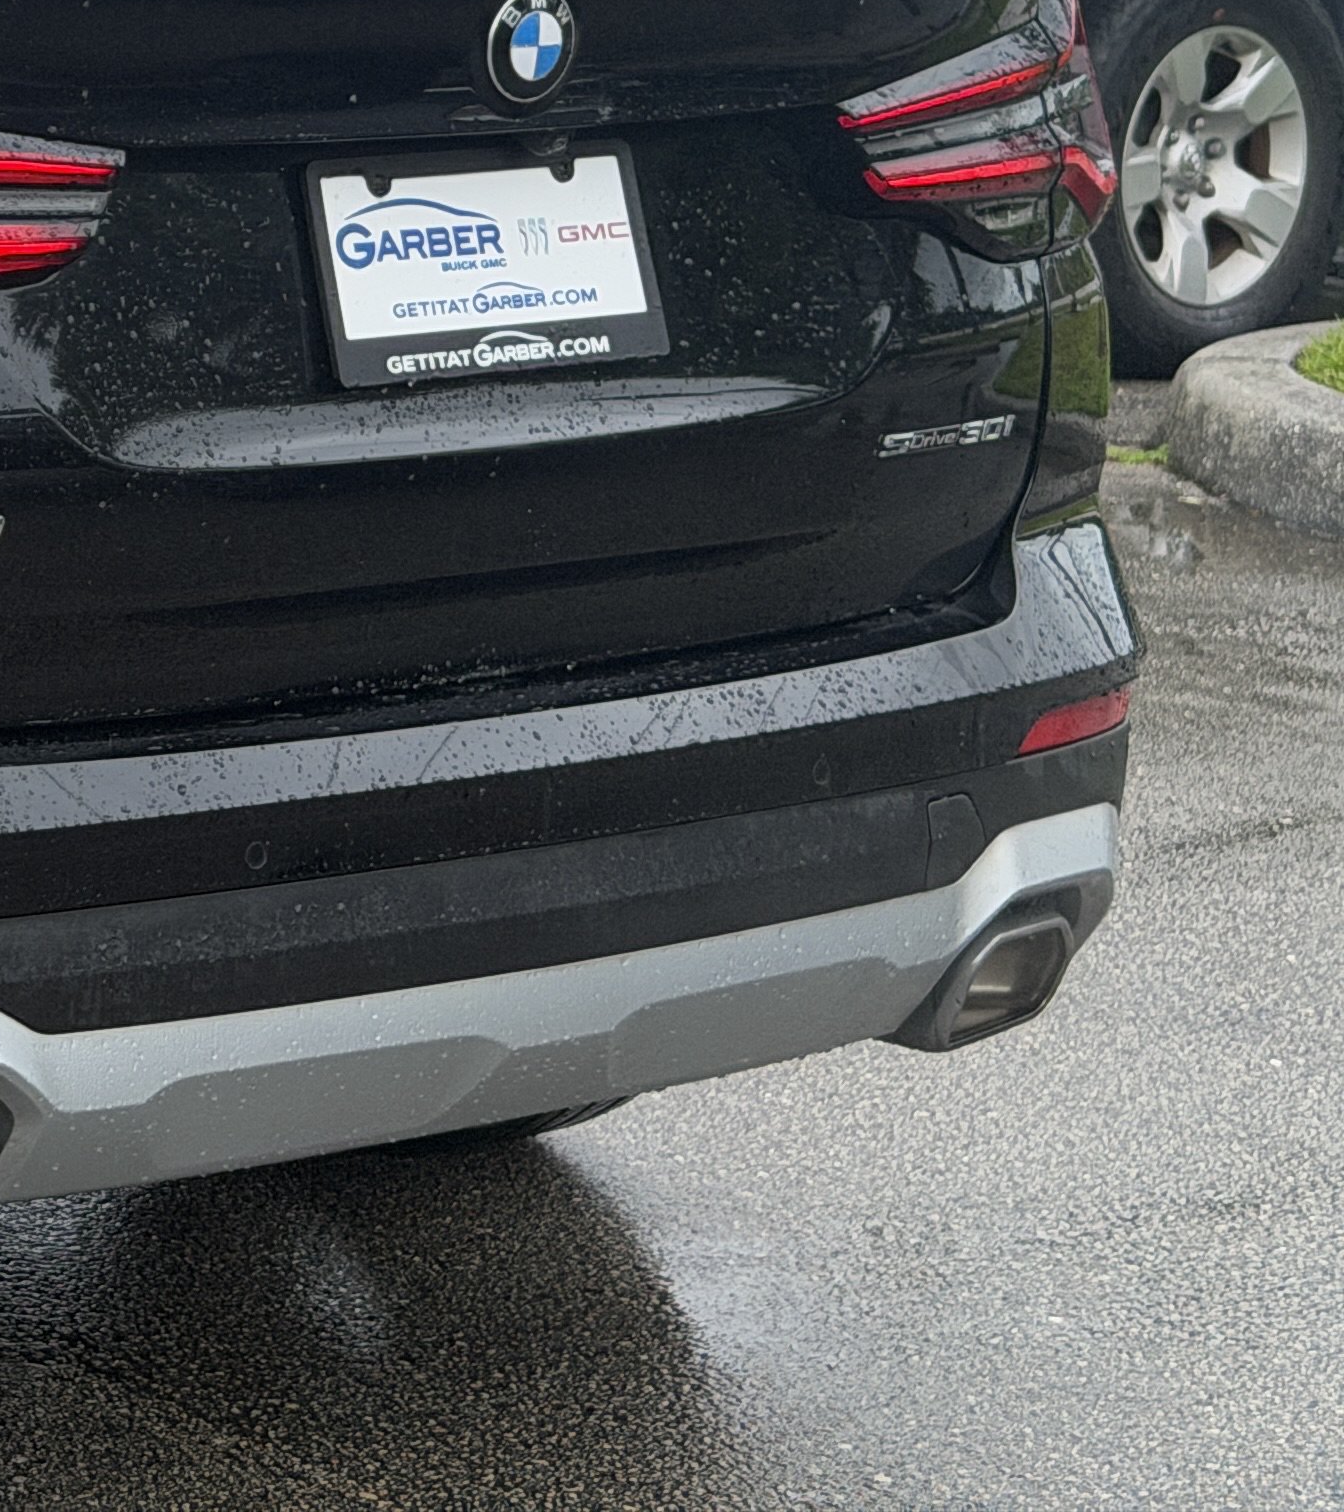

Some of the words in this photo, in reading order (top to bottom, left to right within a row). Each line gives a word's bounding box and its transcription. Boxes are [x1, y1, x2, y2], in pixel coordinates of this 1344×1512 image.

[335, 222, 505, 270] GARBER
[557, 221, 630, 244] GMC
[441, 259, 478, 272] BUICK
[480, 257, 508, 270] GMC
[392, 287, 599, 319] GETITATGARBER.COM
[386, 335, 611, 375] GETITATGARBER.COM
